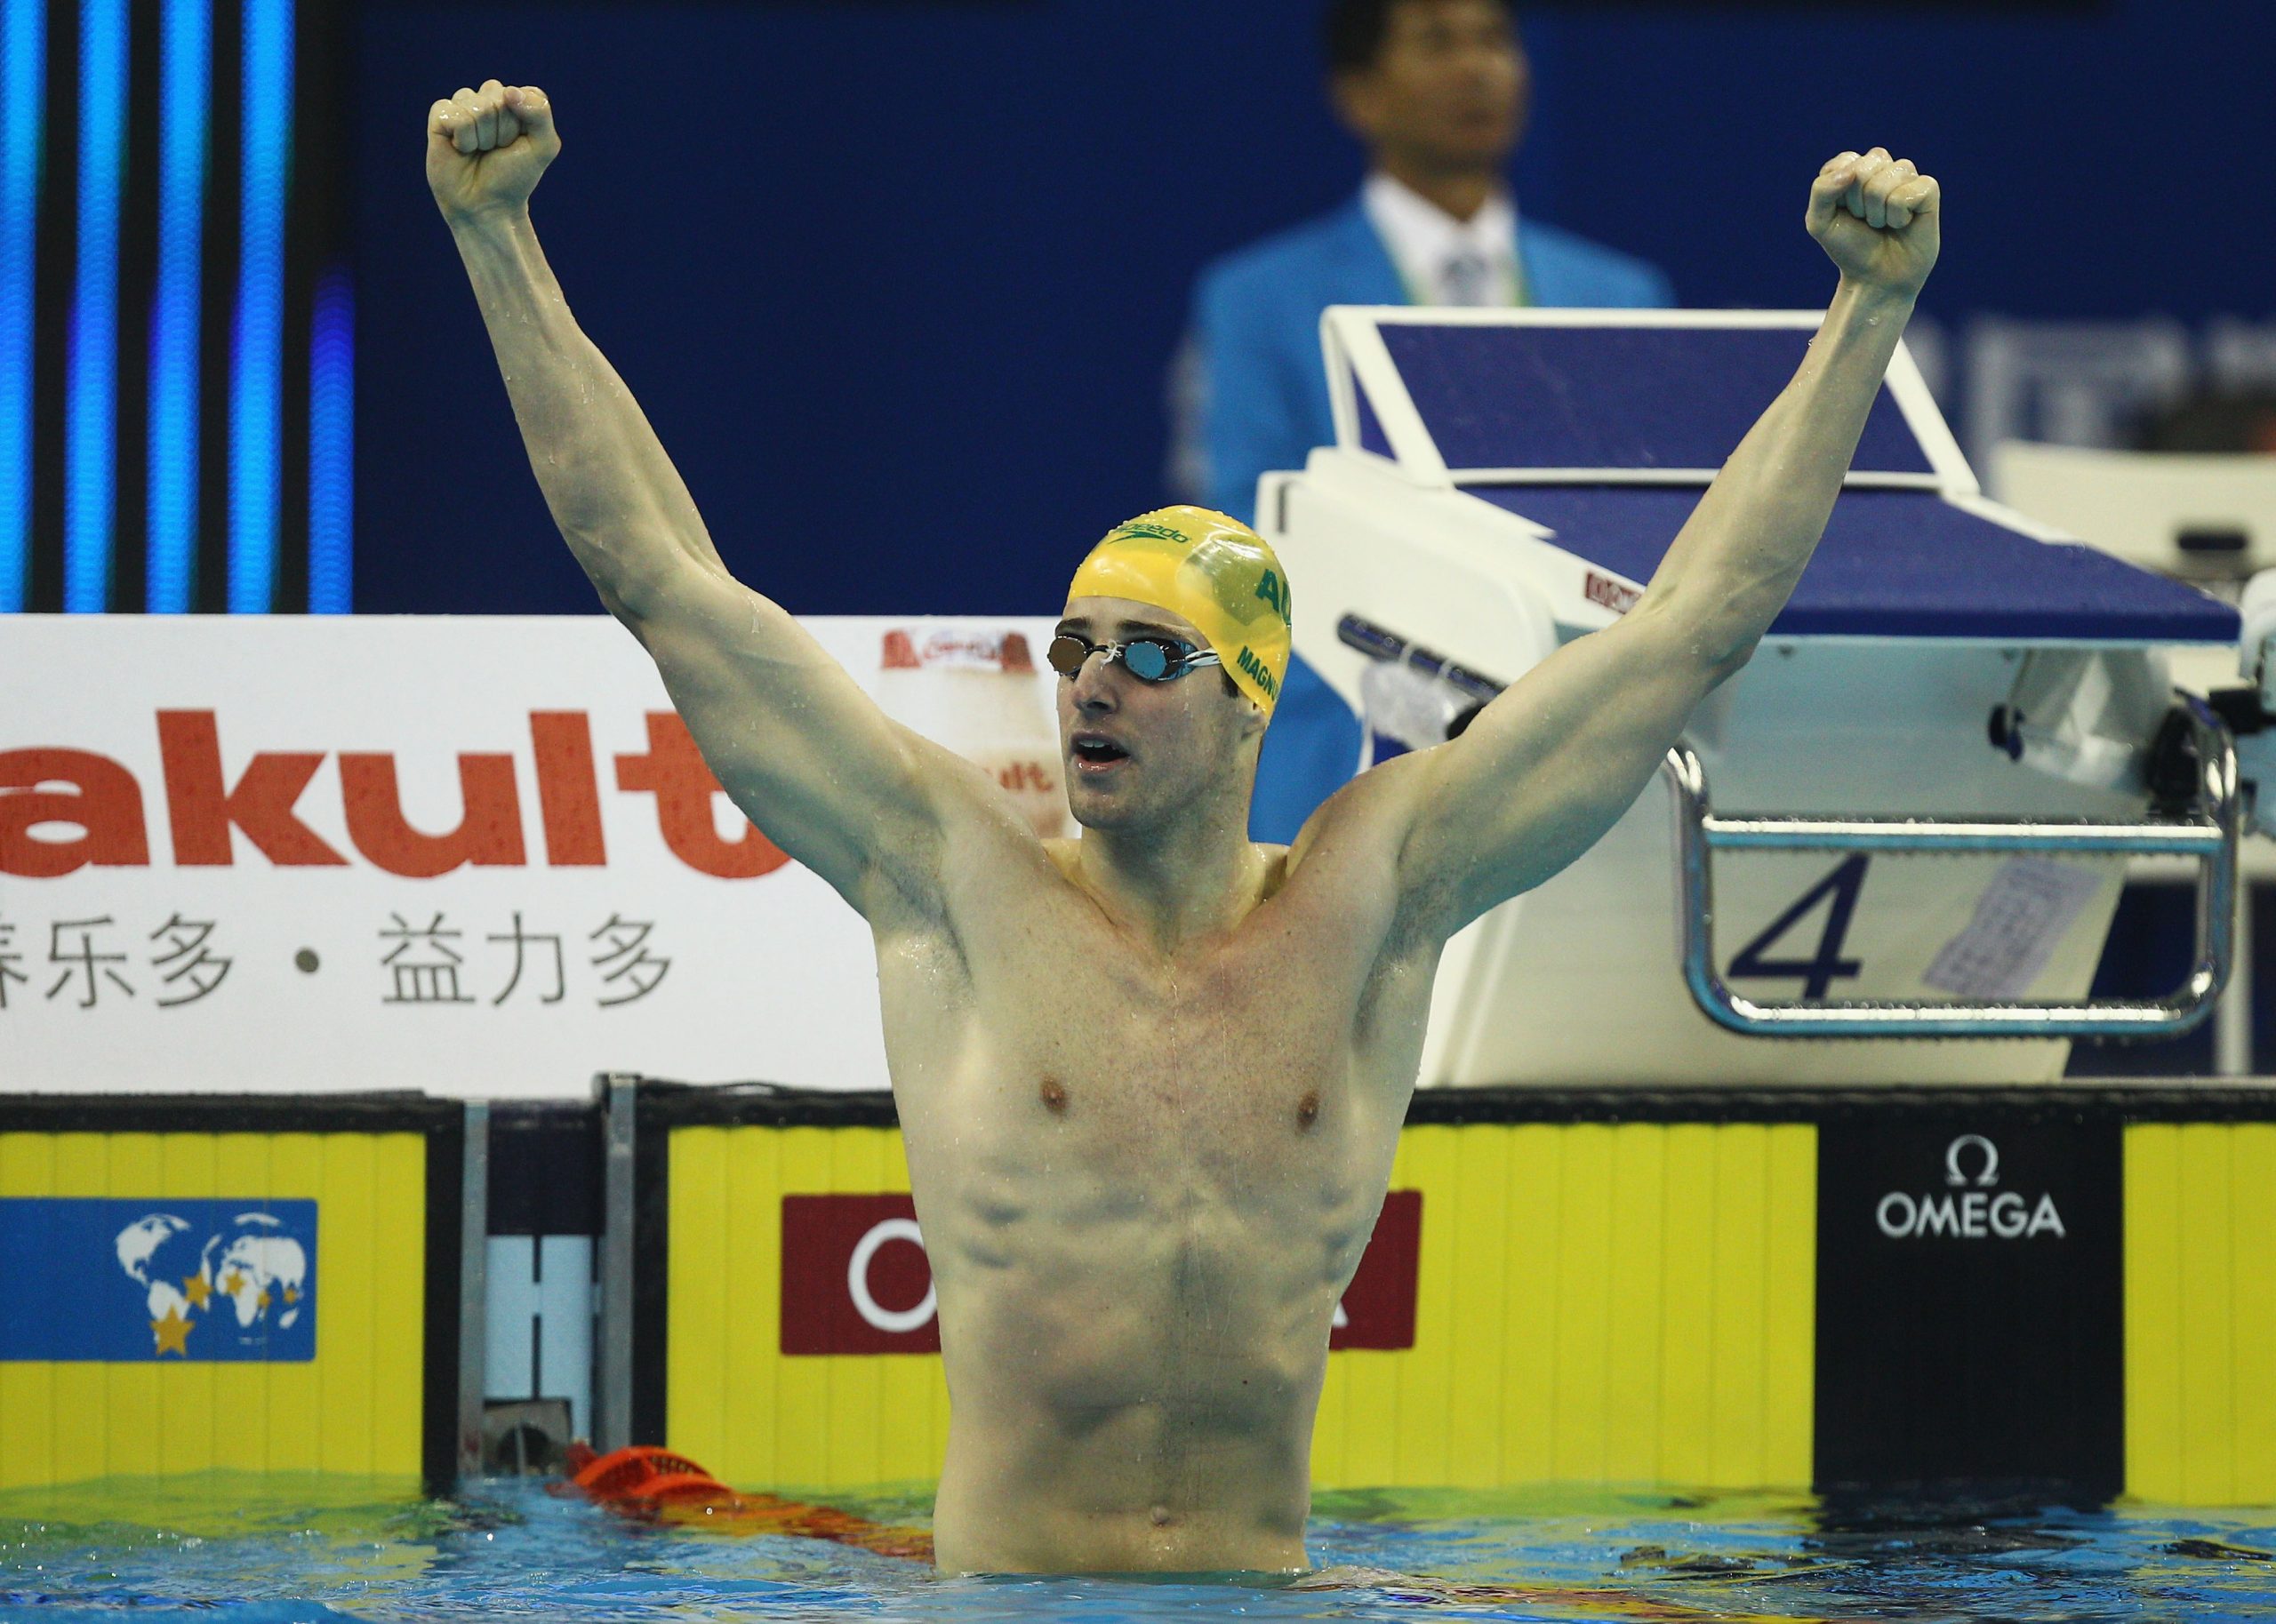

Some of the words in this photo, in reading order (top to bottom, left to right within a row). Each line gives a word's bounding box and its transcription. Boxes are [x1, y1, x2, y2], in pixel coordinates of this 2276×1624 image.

[982, 762, 1054, 792] ult
[1727, 853, 1871, 999] 4
[1877, 1192, 2065, 1237] OMEGA
